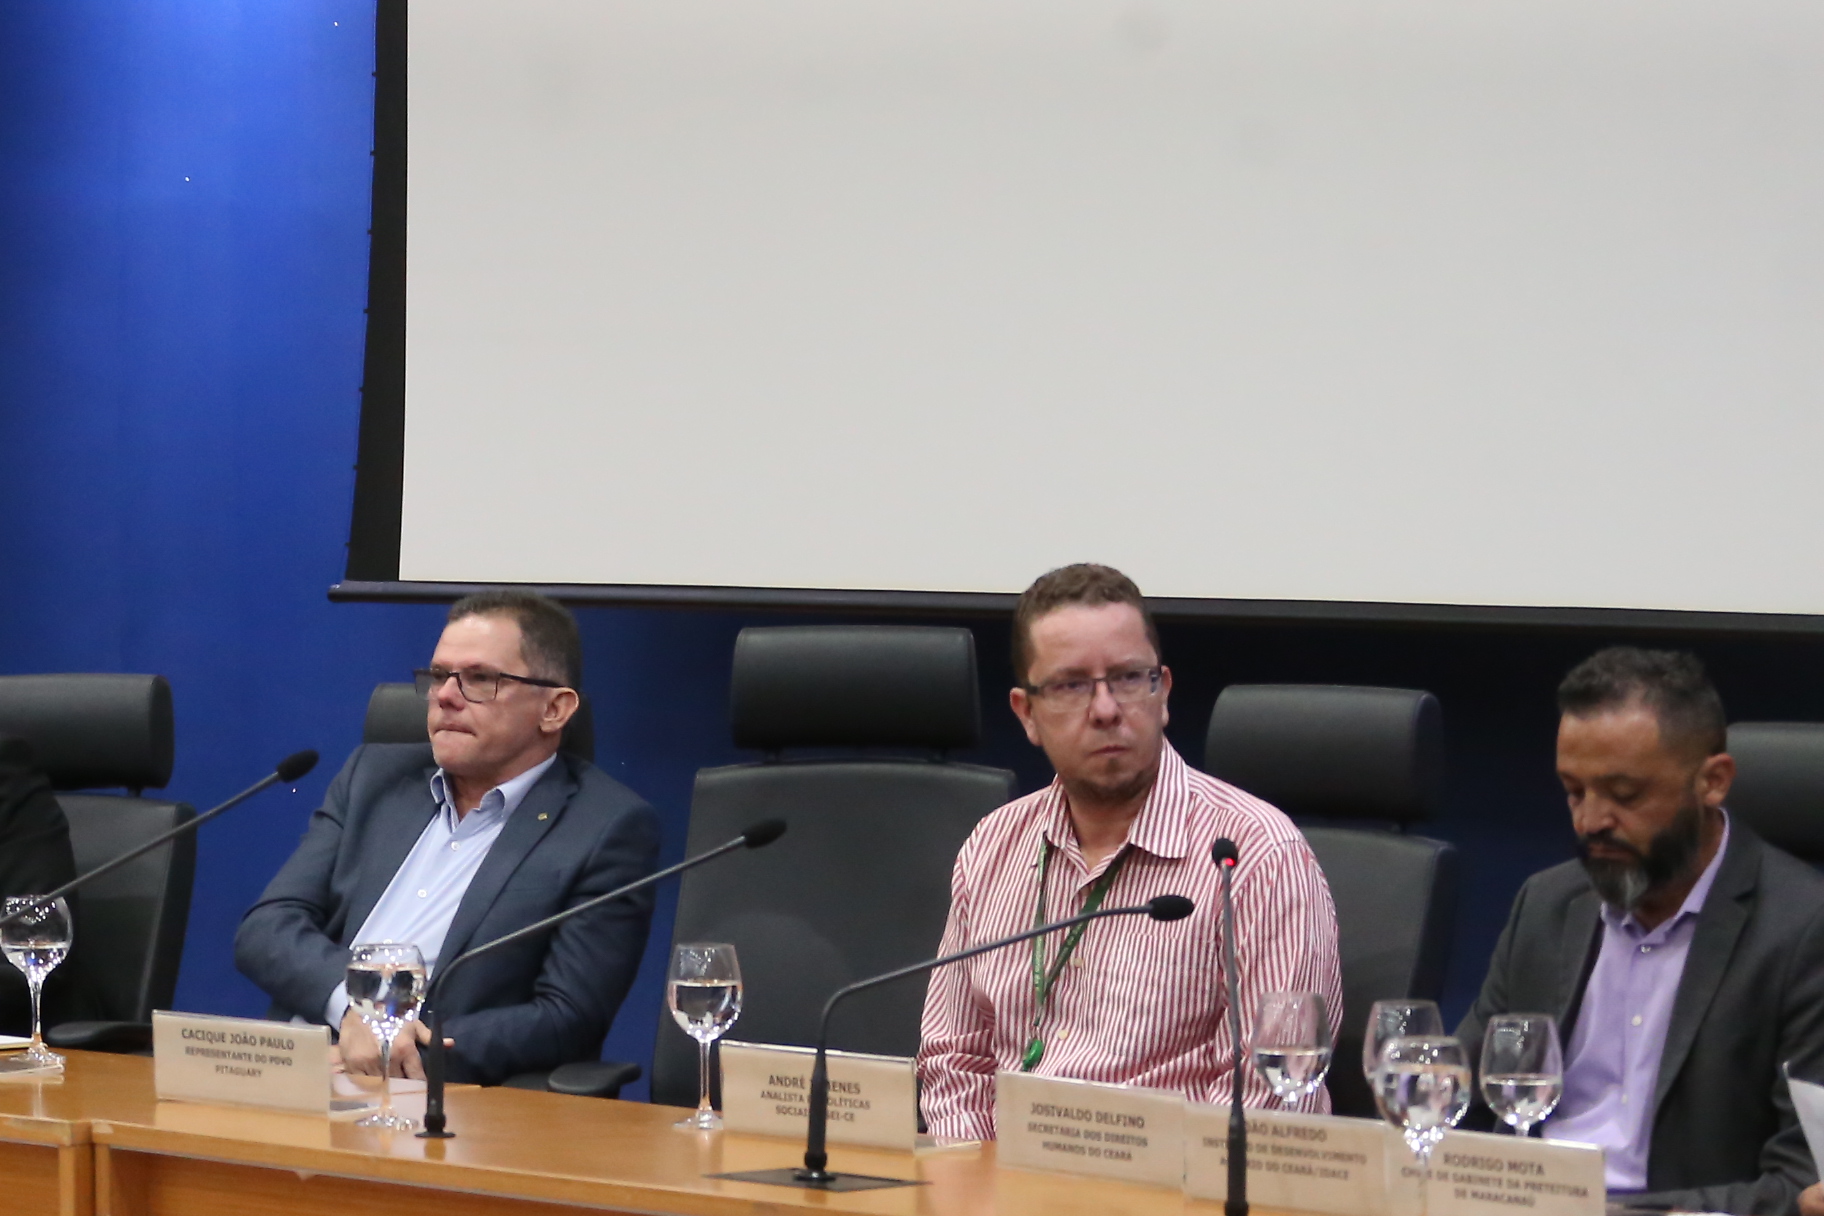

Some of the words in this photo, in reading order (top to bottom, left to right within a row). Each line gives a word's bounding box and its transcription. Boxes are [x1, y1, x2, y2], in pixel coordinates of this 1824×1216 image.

[181, 1028, 226, 1044] CACIQUE
[230, 1031, 257, 1046] JOÃO
[260, 1036, 295, 1050] PAULO
[185, 1046, 252, 1062] REPRESENTANTE
[255, 1053, 267, 1063] DO
[269, 1055, 293, 1066] POVO
[215, 1064, 262, 1077] PITAGUARY
[769, 1074, 805, 1090] ANDRÉ
[761, 1091, 804, 1103] ANALISTA
[1031, 1102, 1092, 1122] JOSIVALDO
[1095, 1110, 1145, 1129] DELFINO
[1028, 1121, 1080, 1138] SECRETARIA
[1083, 1129, 1102, 1142] DOS
[1104, 1132, 1149, 1148] DIREITOS
[1271, 1122, 1328, 1142] ALFREDO
[1042, 1140, 1086, 1156] HUMANOS
[1088, 1146, 1101, 1157] DO
[1443, 1152, 1504, 1172] RODRIGO
[1507, 1160, 1544, 1176] MOTA
